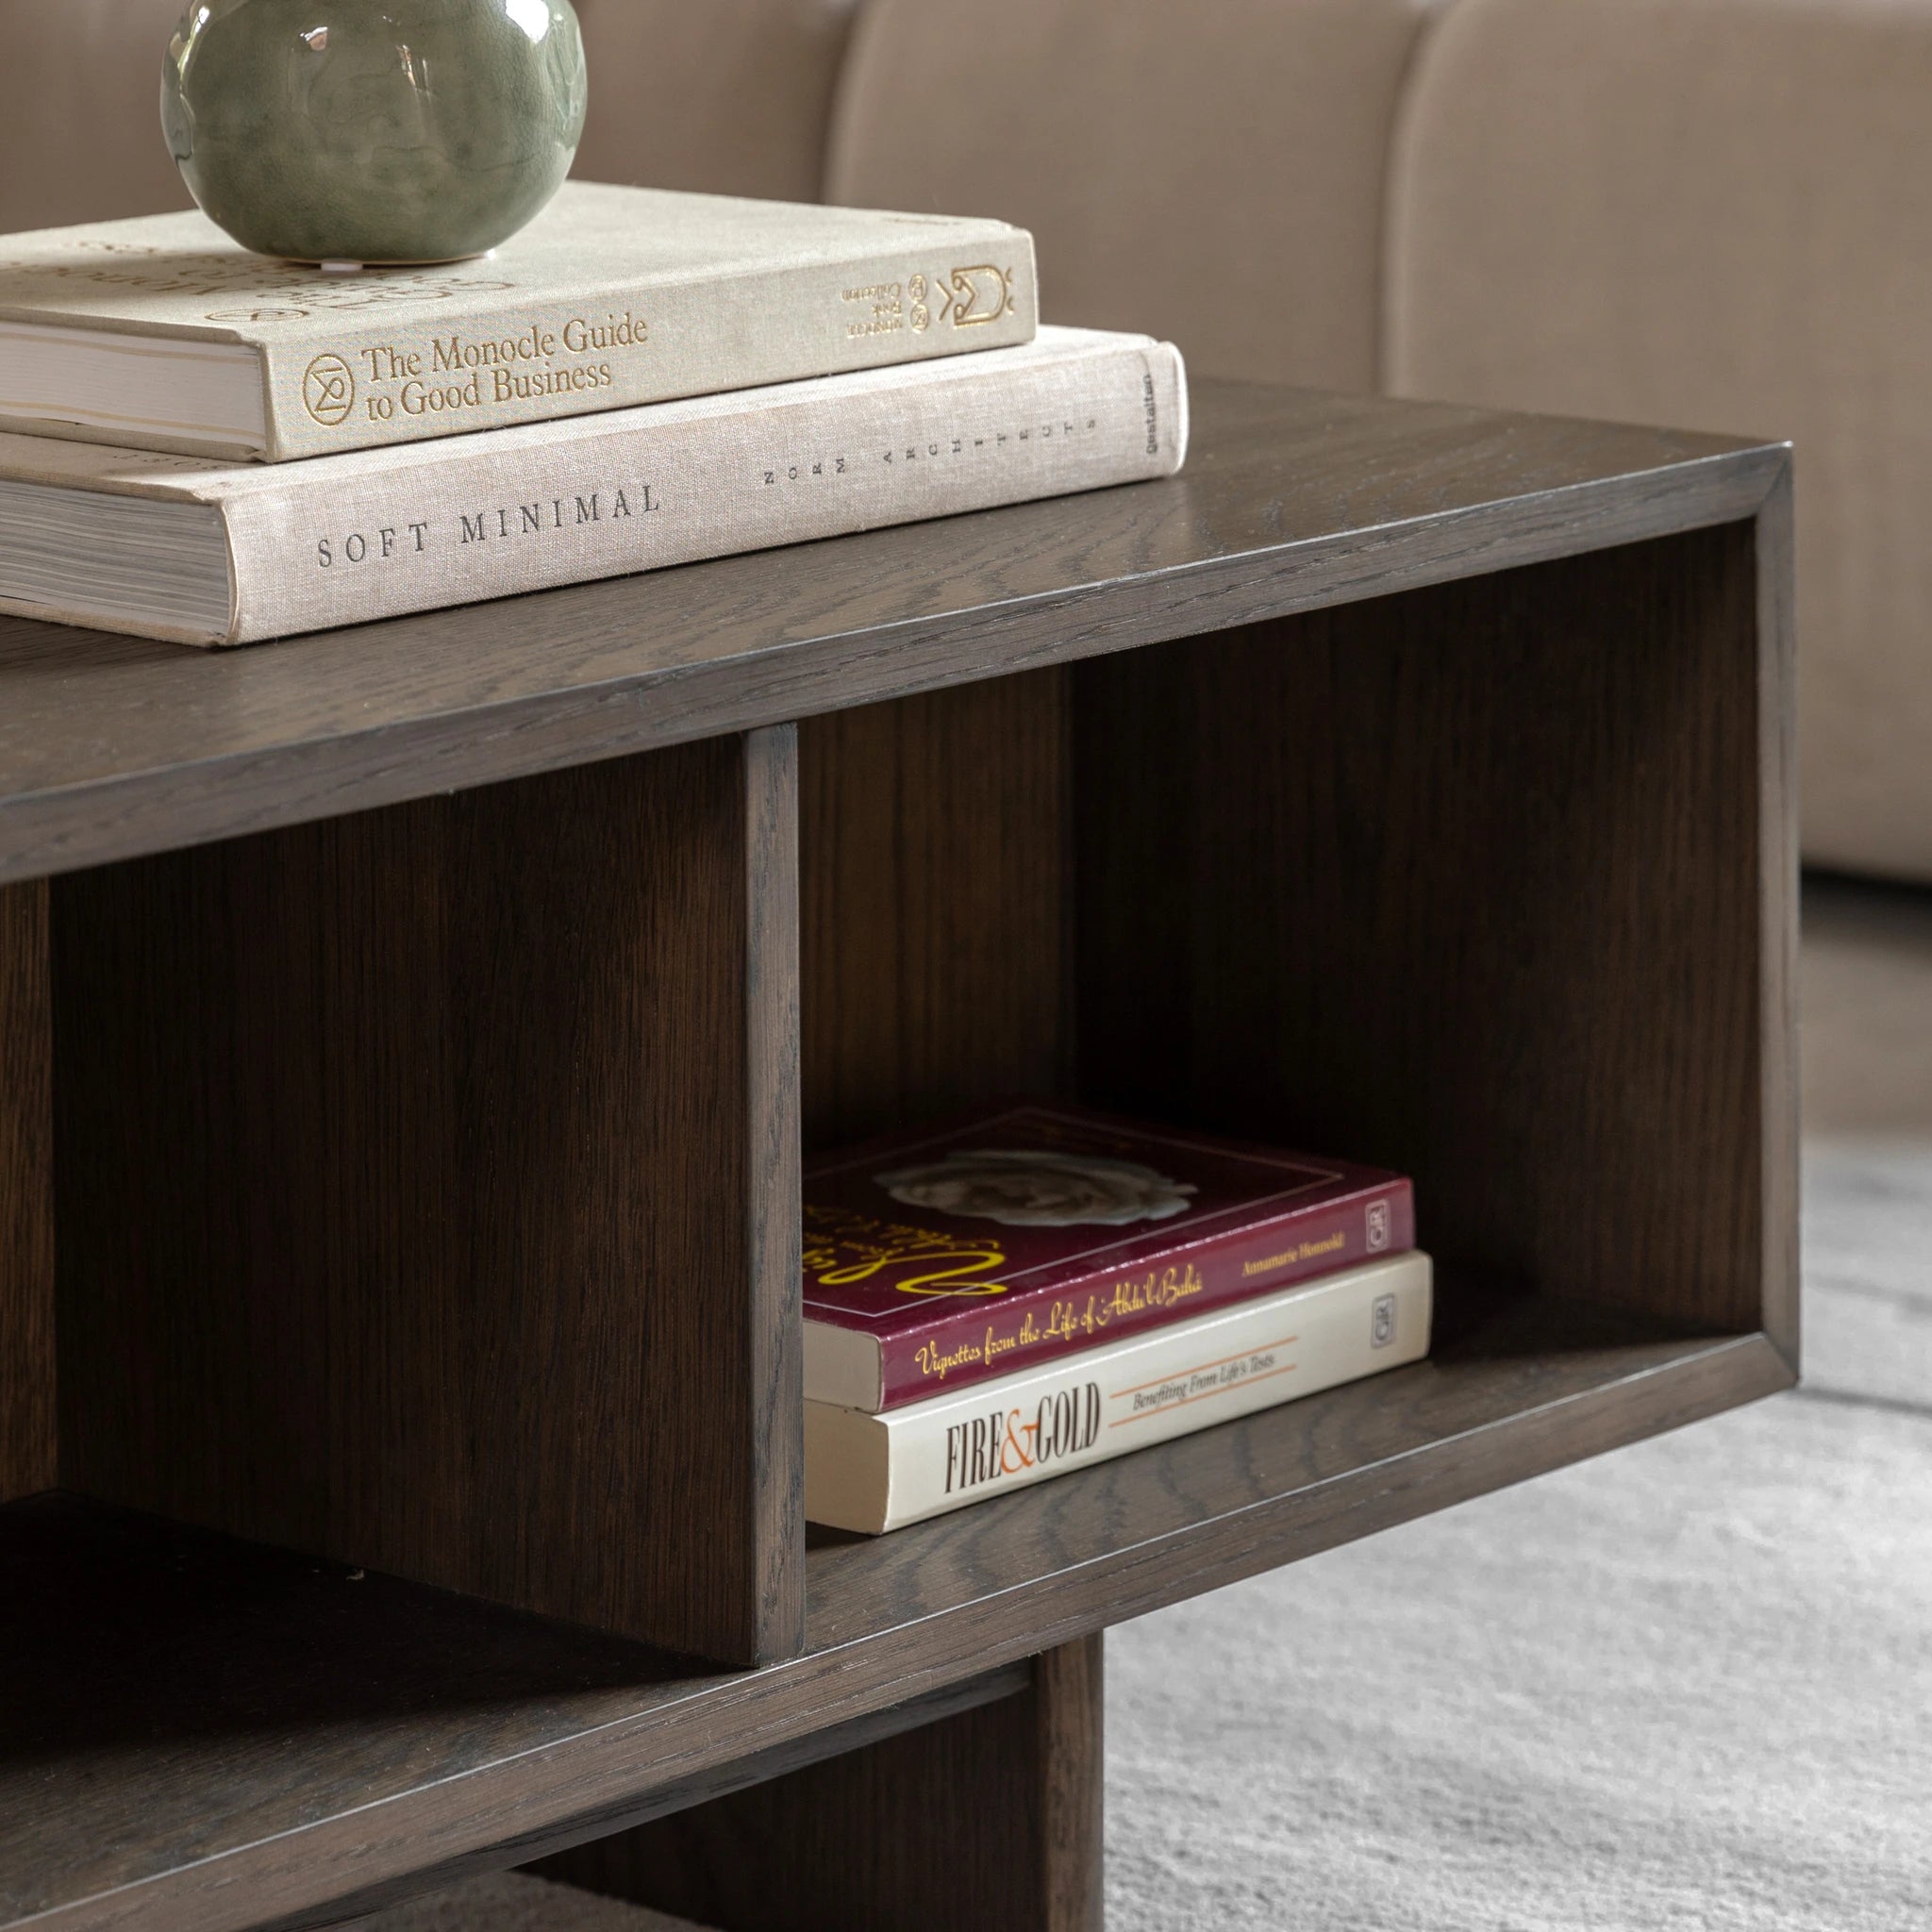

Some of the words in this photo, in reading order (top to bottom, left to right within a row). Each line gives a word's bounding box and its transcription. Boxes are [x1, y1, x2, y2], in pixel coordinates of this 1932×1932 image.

[361, 345, 421, 383] The
[431, 325, 555, 375] Monocle
[563, 311, 649, 355] Guide
[365, 394, 394, 422] to
[400, 372, 481, 417] Good
[491, 360, 612, 404] Business
[1142, 374, 1158, 455] gestalten
[763, 456, 846, 485] NORM
[881, 418, 1096, 464] ARCHITECTS
[317, 521, 428, 568] SOFT
[458, 484, 660, 543] MINIMAL
[914, 1340, 981, 1380] Vignettes
[984, 1326, 1016, 1366] from
[1019, 1312, 1040, 1346] the
[1042, 1301, 1078, 1341] Life
[1080, 1295, 1095, 1334] of
[1133, 1380, 1188, 1410] Benefiting
[1189, 1371, 1218, 1393] From
[1219, 1360, 1247, 1386] Life's
[1249, 1352, 1276, 1374] Tests
